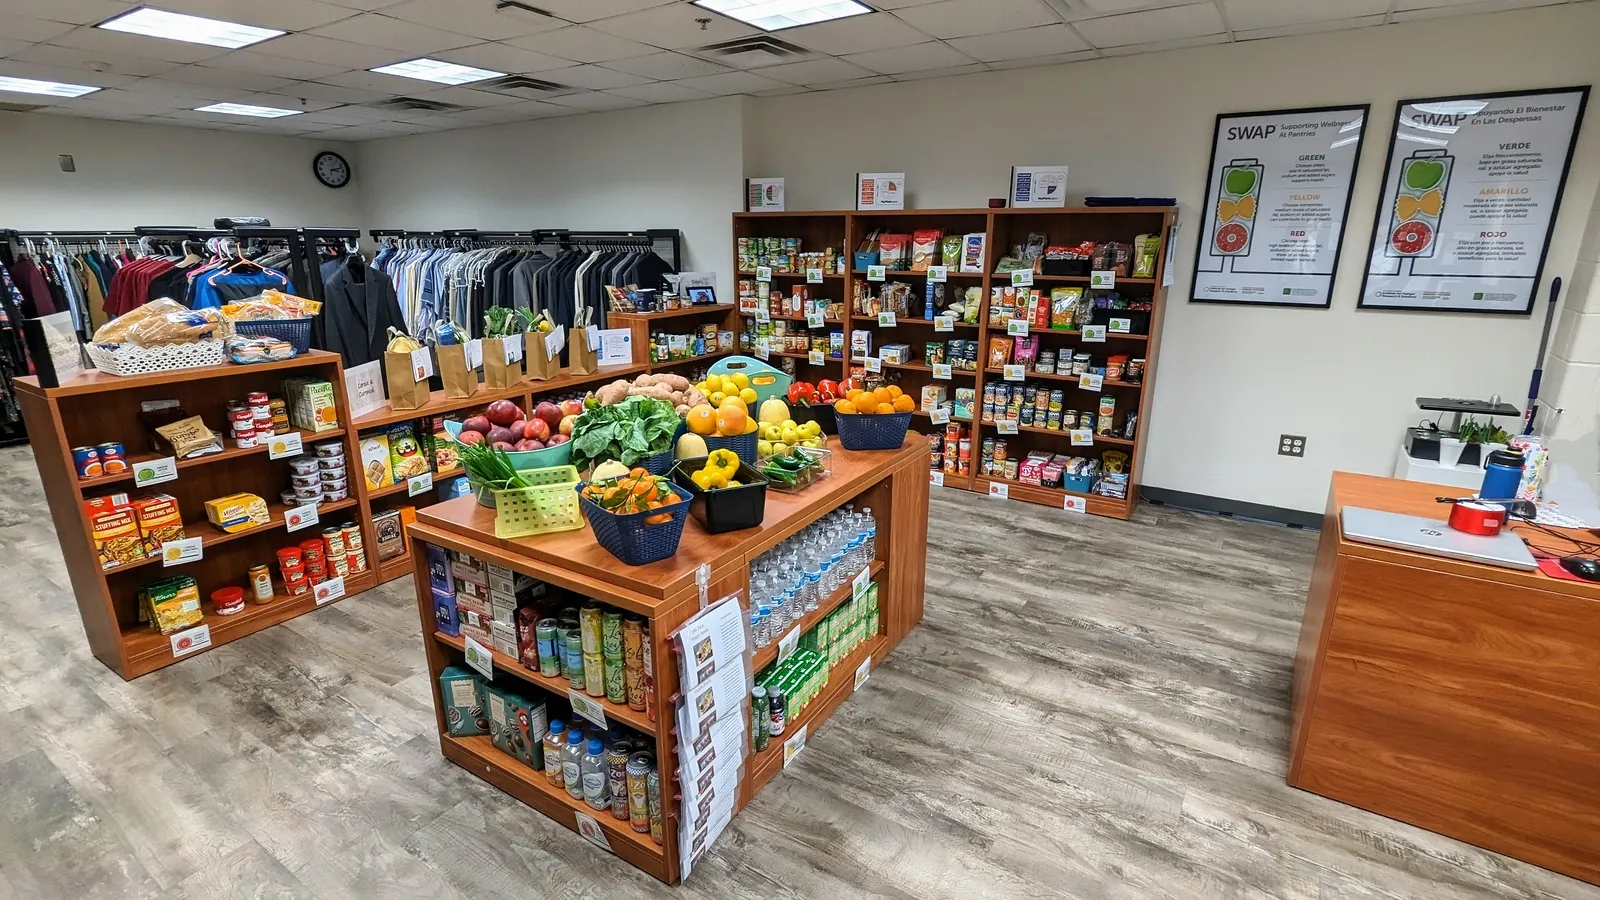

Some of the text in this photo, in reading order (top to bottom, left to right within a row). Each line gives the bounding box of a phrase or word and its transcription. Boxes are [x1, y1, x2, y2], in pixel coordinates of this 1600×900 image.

[1516, 106, 1524, 114] El
[1525, 105, 1566, 113] Bienestar
[1498, 115, 1542, 125] Despensas
[1280, 122, 1319, 131] Supporting
[1227, 124, 1276, 140] SWAP
[1288, 130, 1316, 138] Pantries
[1499, 142, 1531, 150] VERDE
[1479, 187, 1529, 195] AMARILLO
[1289, 193, 1321, 201] YELLOW
[311, 383, 332, 395] Pacific
[169, 428, 200, 443] Gumbo
[143, 506, 176, 520] STUFFING MIX
[95, 517, 132, 531] STUFFING MIX
